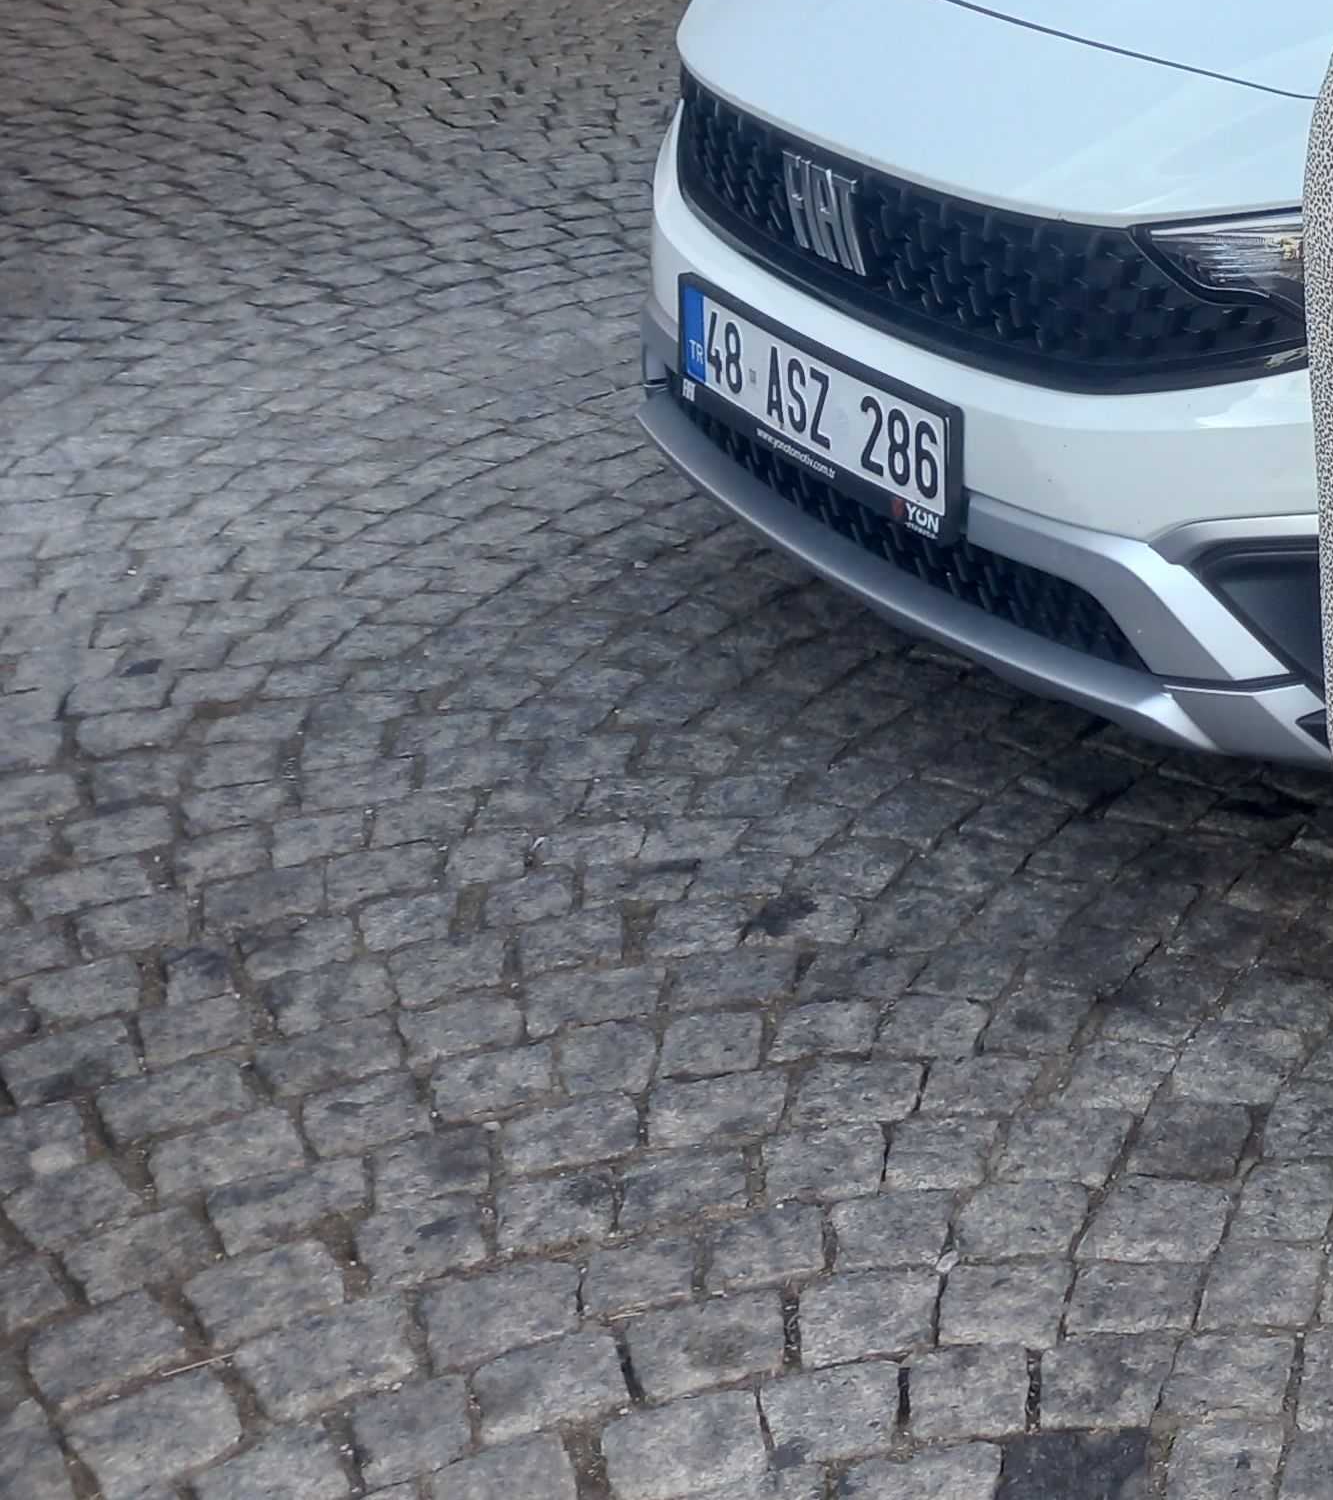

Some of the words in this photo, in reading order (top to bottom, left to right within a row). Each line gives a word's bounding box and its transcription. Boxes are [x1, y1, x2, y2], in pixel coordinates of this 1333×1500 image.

[782, 150, 867, 277] FIAT
[689, 339, 704, 365] TR
[706, 311, 743, 395] 48
[767, 346, 832, 451] ASZ
[860, 395, 938, 500] 286
